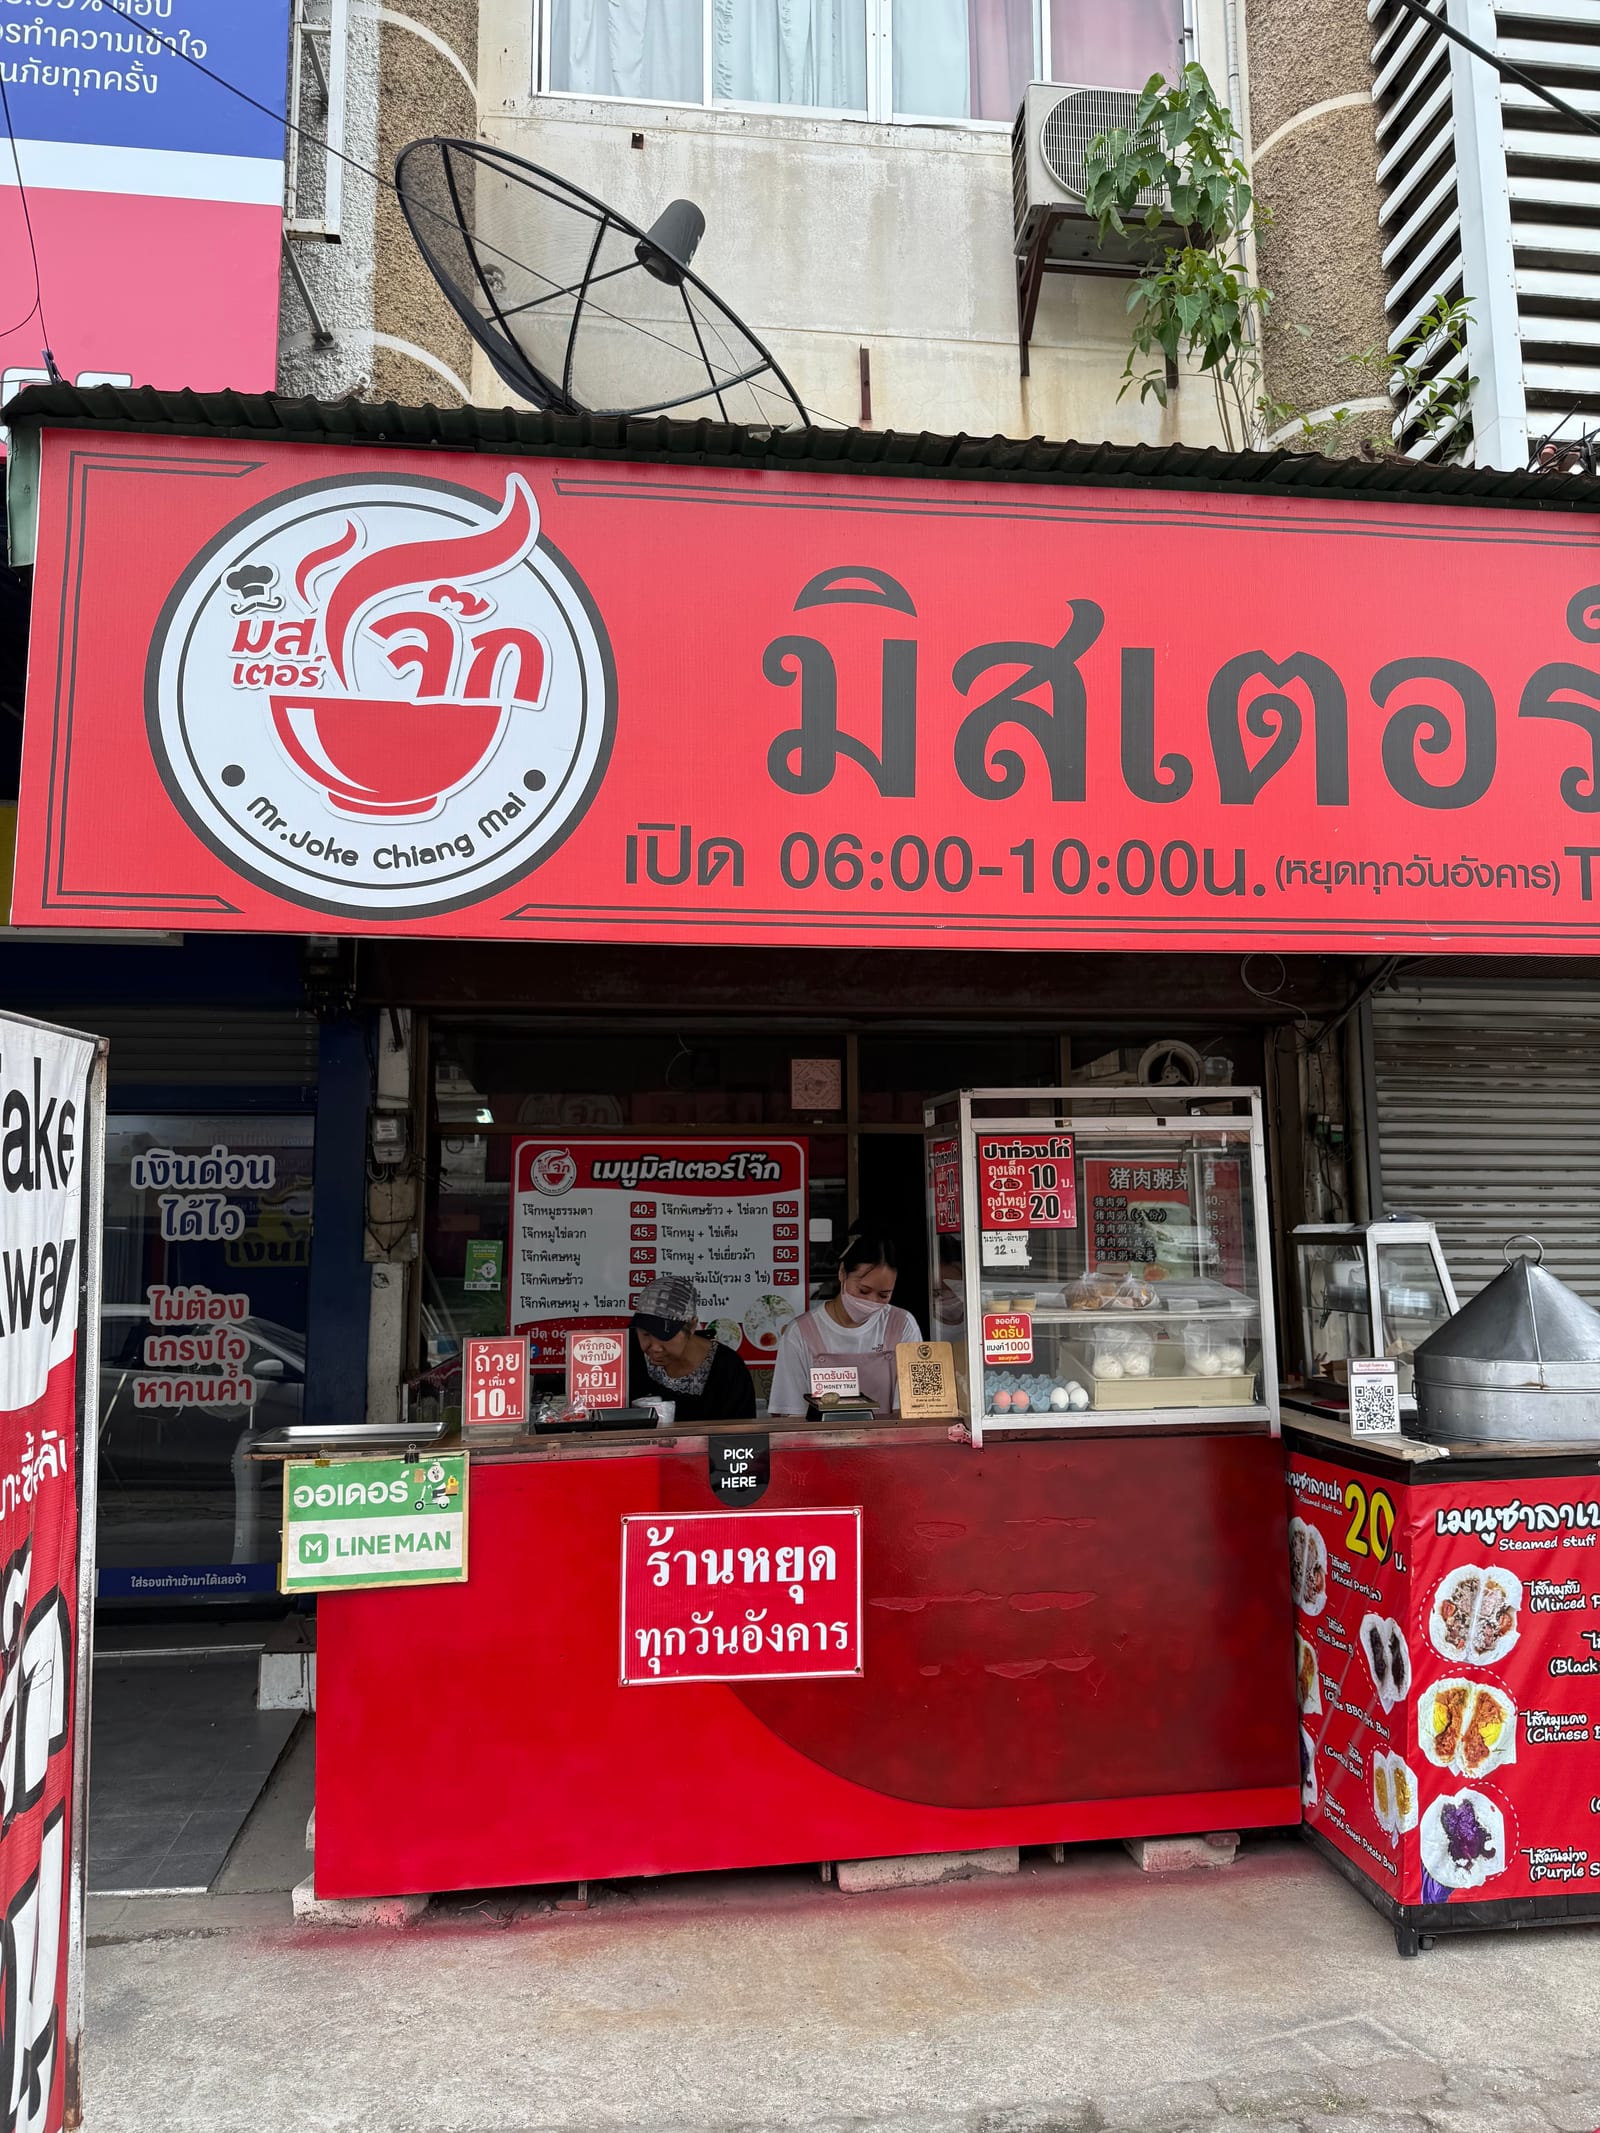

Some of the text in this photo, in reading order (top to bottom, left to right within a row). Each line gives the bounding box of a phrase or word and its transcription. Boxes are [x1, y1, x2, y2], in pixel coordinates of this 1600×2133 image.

[247, 792, 527, 869] Mr.Joke Chiang Mai
[625, 822, 745, 888] เปิด
[1275, 854, 1561, 897] (หยุดทุกวันอังคาร)
[0, 1057, 76, 1192] ake
[134, 1149, 274, 1187] เงินด่วน
[988, 1160, 1025, 1180] ถุงเล็ก
[1028, 1163, 1057, 1191] 10
[161, 1194, 244, 1238] ได้ไว
[522, 1203, 593, 1220] โจ๊กหมูธรรมดา
[737, 1202, 768, 1215] ไข่ลวก
[1029, 1194, 1060, 1220] 20
[521, 1225, 587, 1243] โจ๊กหมูไข่ลวก
[661, 1225, 695, 1242] โจ๊กหมู
[661, 1247, 695, 1265] โจ๊กหมู
[0, 1238, 76, 1342] way
[744, 1274, 751, 1283] 3
[151, 1289, 245, 1321] ไม่ต้อง
[594, 1295, 626, 1309] ไข่ลวก
[991, 1324, 1025, 1339] งดรับ
[148, 1328, 246, 1362] เกรงใจ
[474, 1344, 520, 1373] ถ้วย
[137, 1363, 253, 1403] หาคนค้ำ
[576, 1365, 617, 1388] หยิบ
[473, 1388, 507, 1417] 10
[723, 1448, 754, 1461] PICK
[729, 1462, 748, 1474] UP
[293, 1469, 410, 1508] ออเดอร์
[721, 1475, 757, 1489] HERE
[1344, 1483, 1395, 1562] 20
[336, 1534, 391, 1558] LINE
[394, 1530, 451, 1554] MAN
[1499, 1534, 1597, 1551] Steamed stuff
[646, 1526, 837, 1605] ร้านหยุด
[1530, 1595, 1586, 1613] (Minced
[635, 1607, 849, 1675] ทุกวันอังคาร
[1550, 1658, 1598, 1675] (Black
[1527, 1727, 1589, 1744] (Chinese
[1530, 1863, 1585, 1881] (Purple
